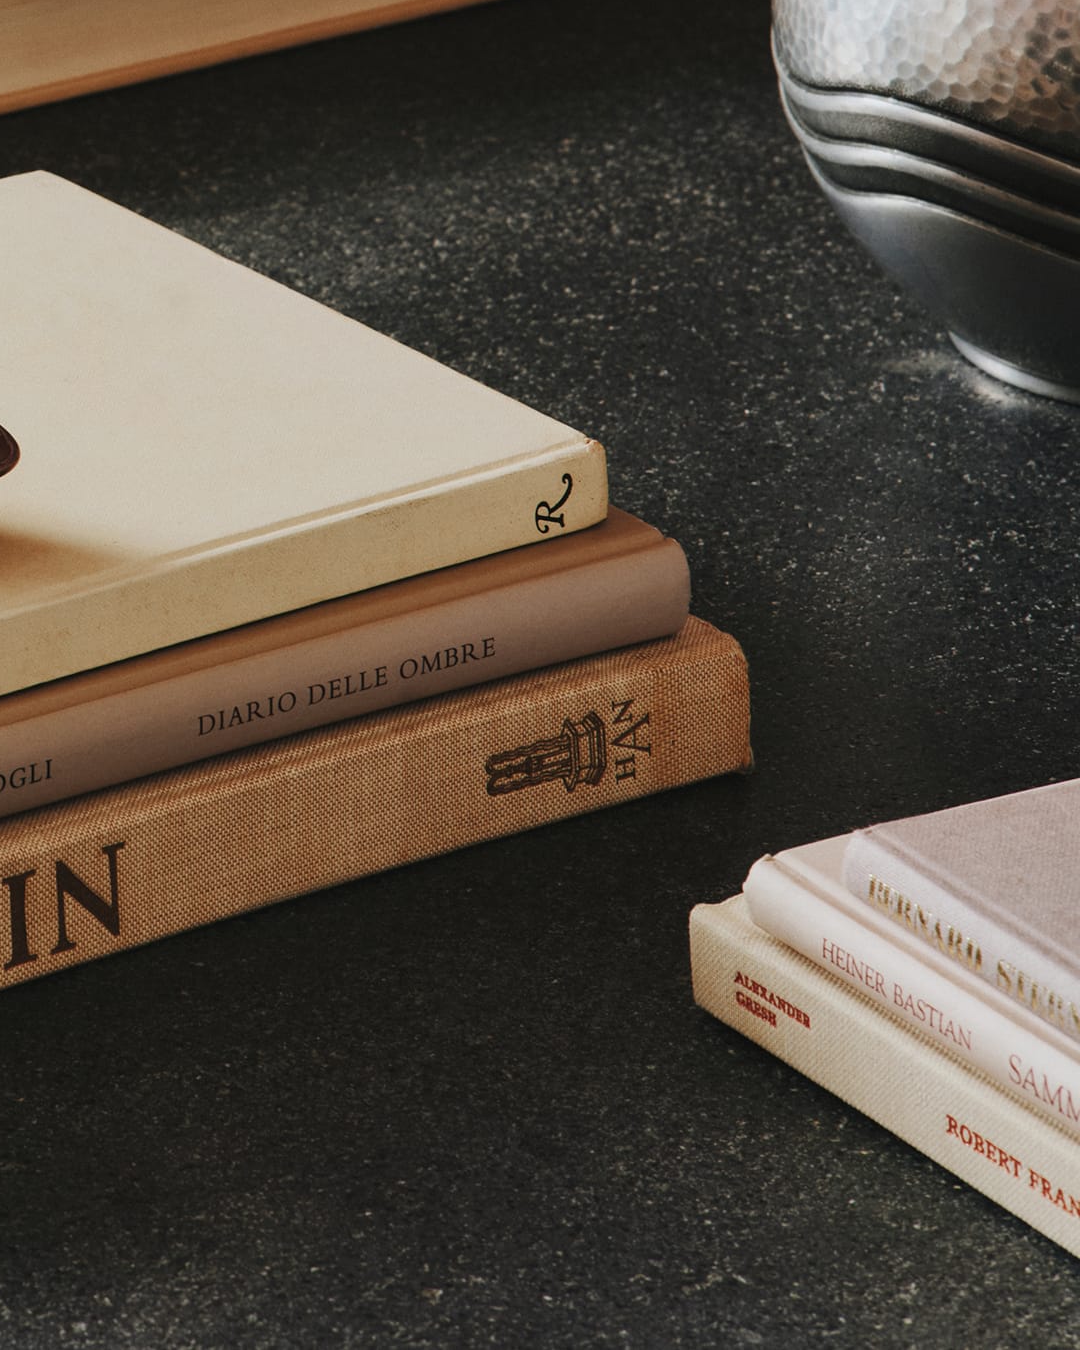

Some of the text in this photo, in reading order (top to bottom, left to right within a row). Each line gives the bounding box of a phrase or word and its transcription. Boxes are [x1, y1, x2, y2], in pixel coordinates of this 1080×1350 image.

[197, 637, 496, 737] DIARIO DELLE OMBRE
[869, 873, 983, 972] BERNARD
[734, 971, 811, 1029] ALEXANDER
[822, 938, 887, 998] HEINER
[894, 983, 972, 1050] BASTIAN
[946, 1114, 1021, 1178] ROBERT
